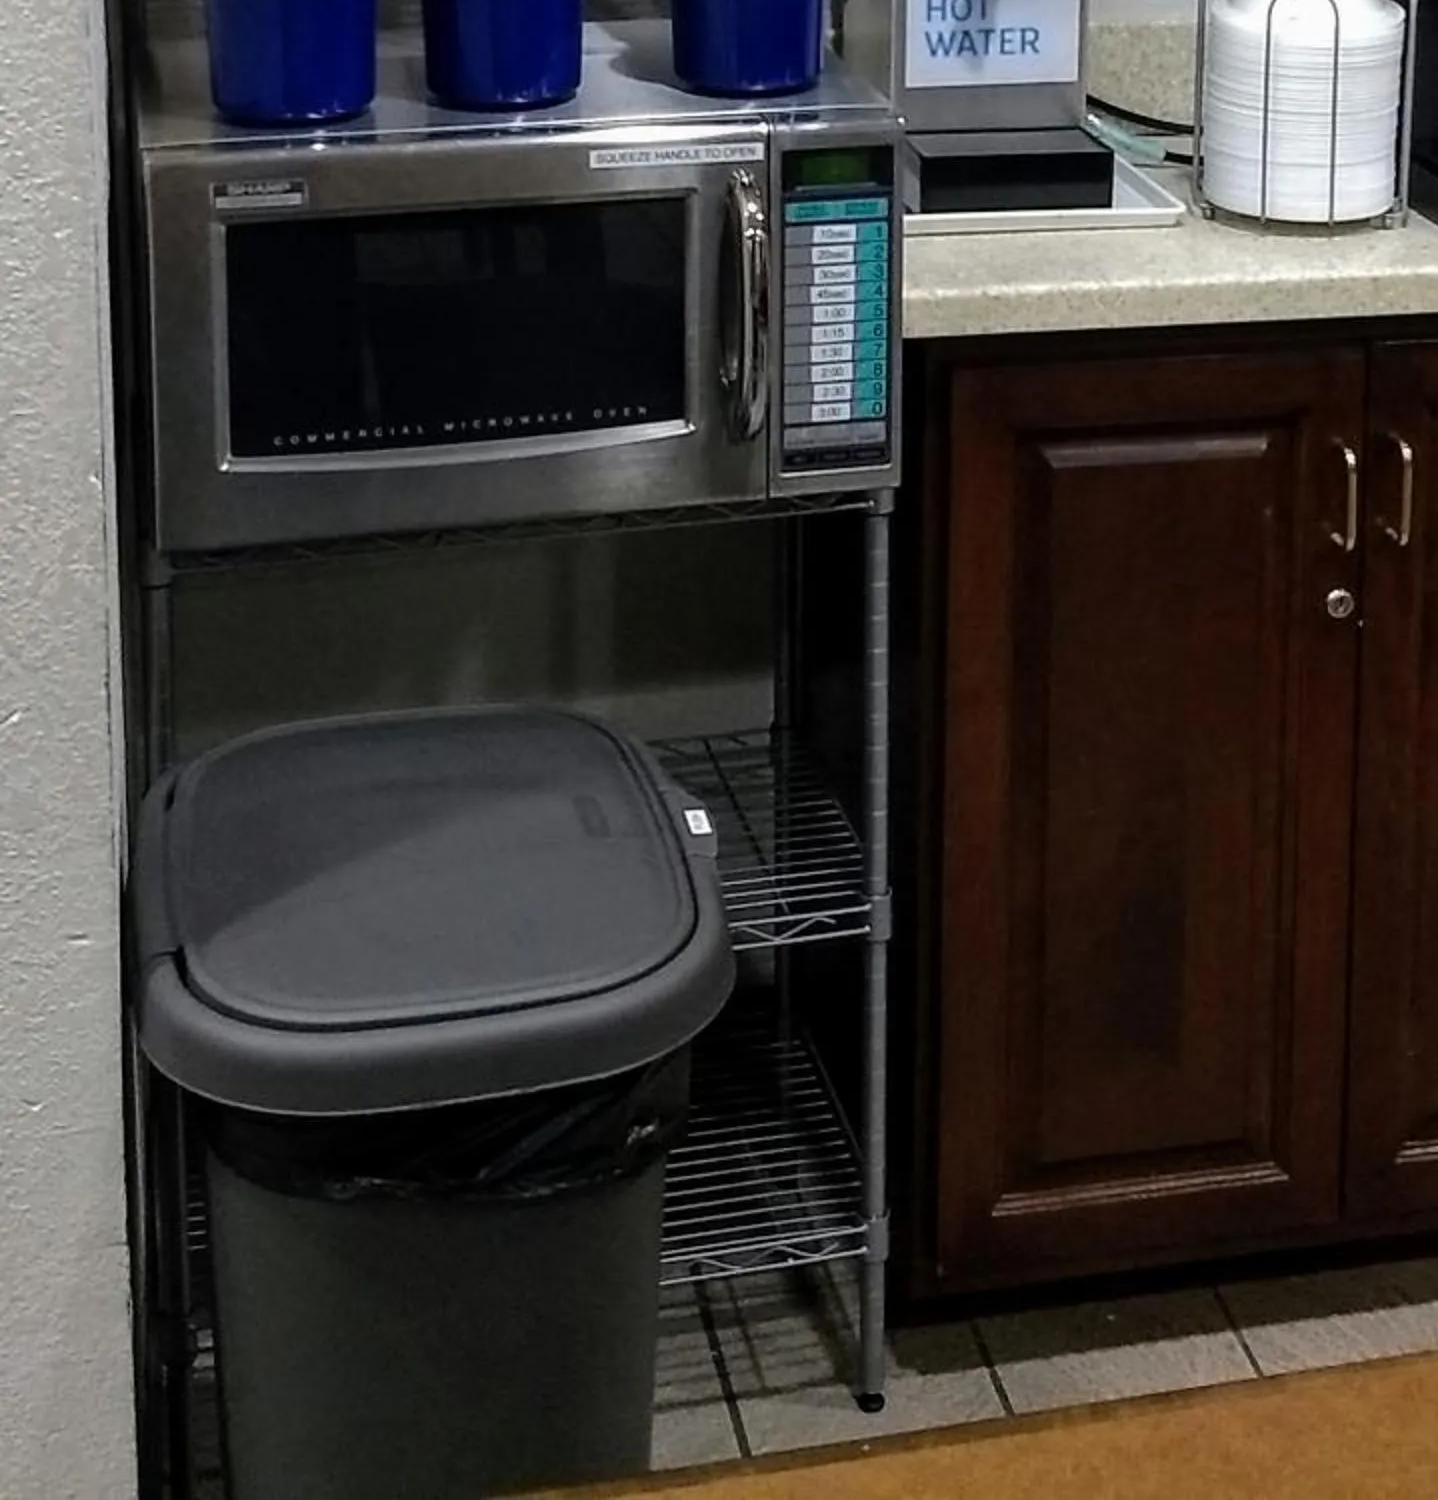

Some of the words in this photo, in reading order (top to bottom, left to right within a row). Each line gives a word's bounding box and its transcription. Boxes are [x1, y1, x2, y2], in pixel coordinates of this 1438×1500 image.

[924, 26, 1041, 57] WATER
[655, 148, 701, 163] HANDLE
[704, 146, 722, 159] TO
[723, 145, 757, 159] OPEN
[272, 424, 424, 447] COMMERCIAL
[443, 410, 574, 431] MICROWAVE
[592, 405, 648, 419] OVEN
